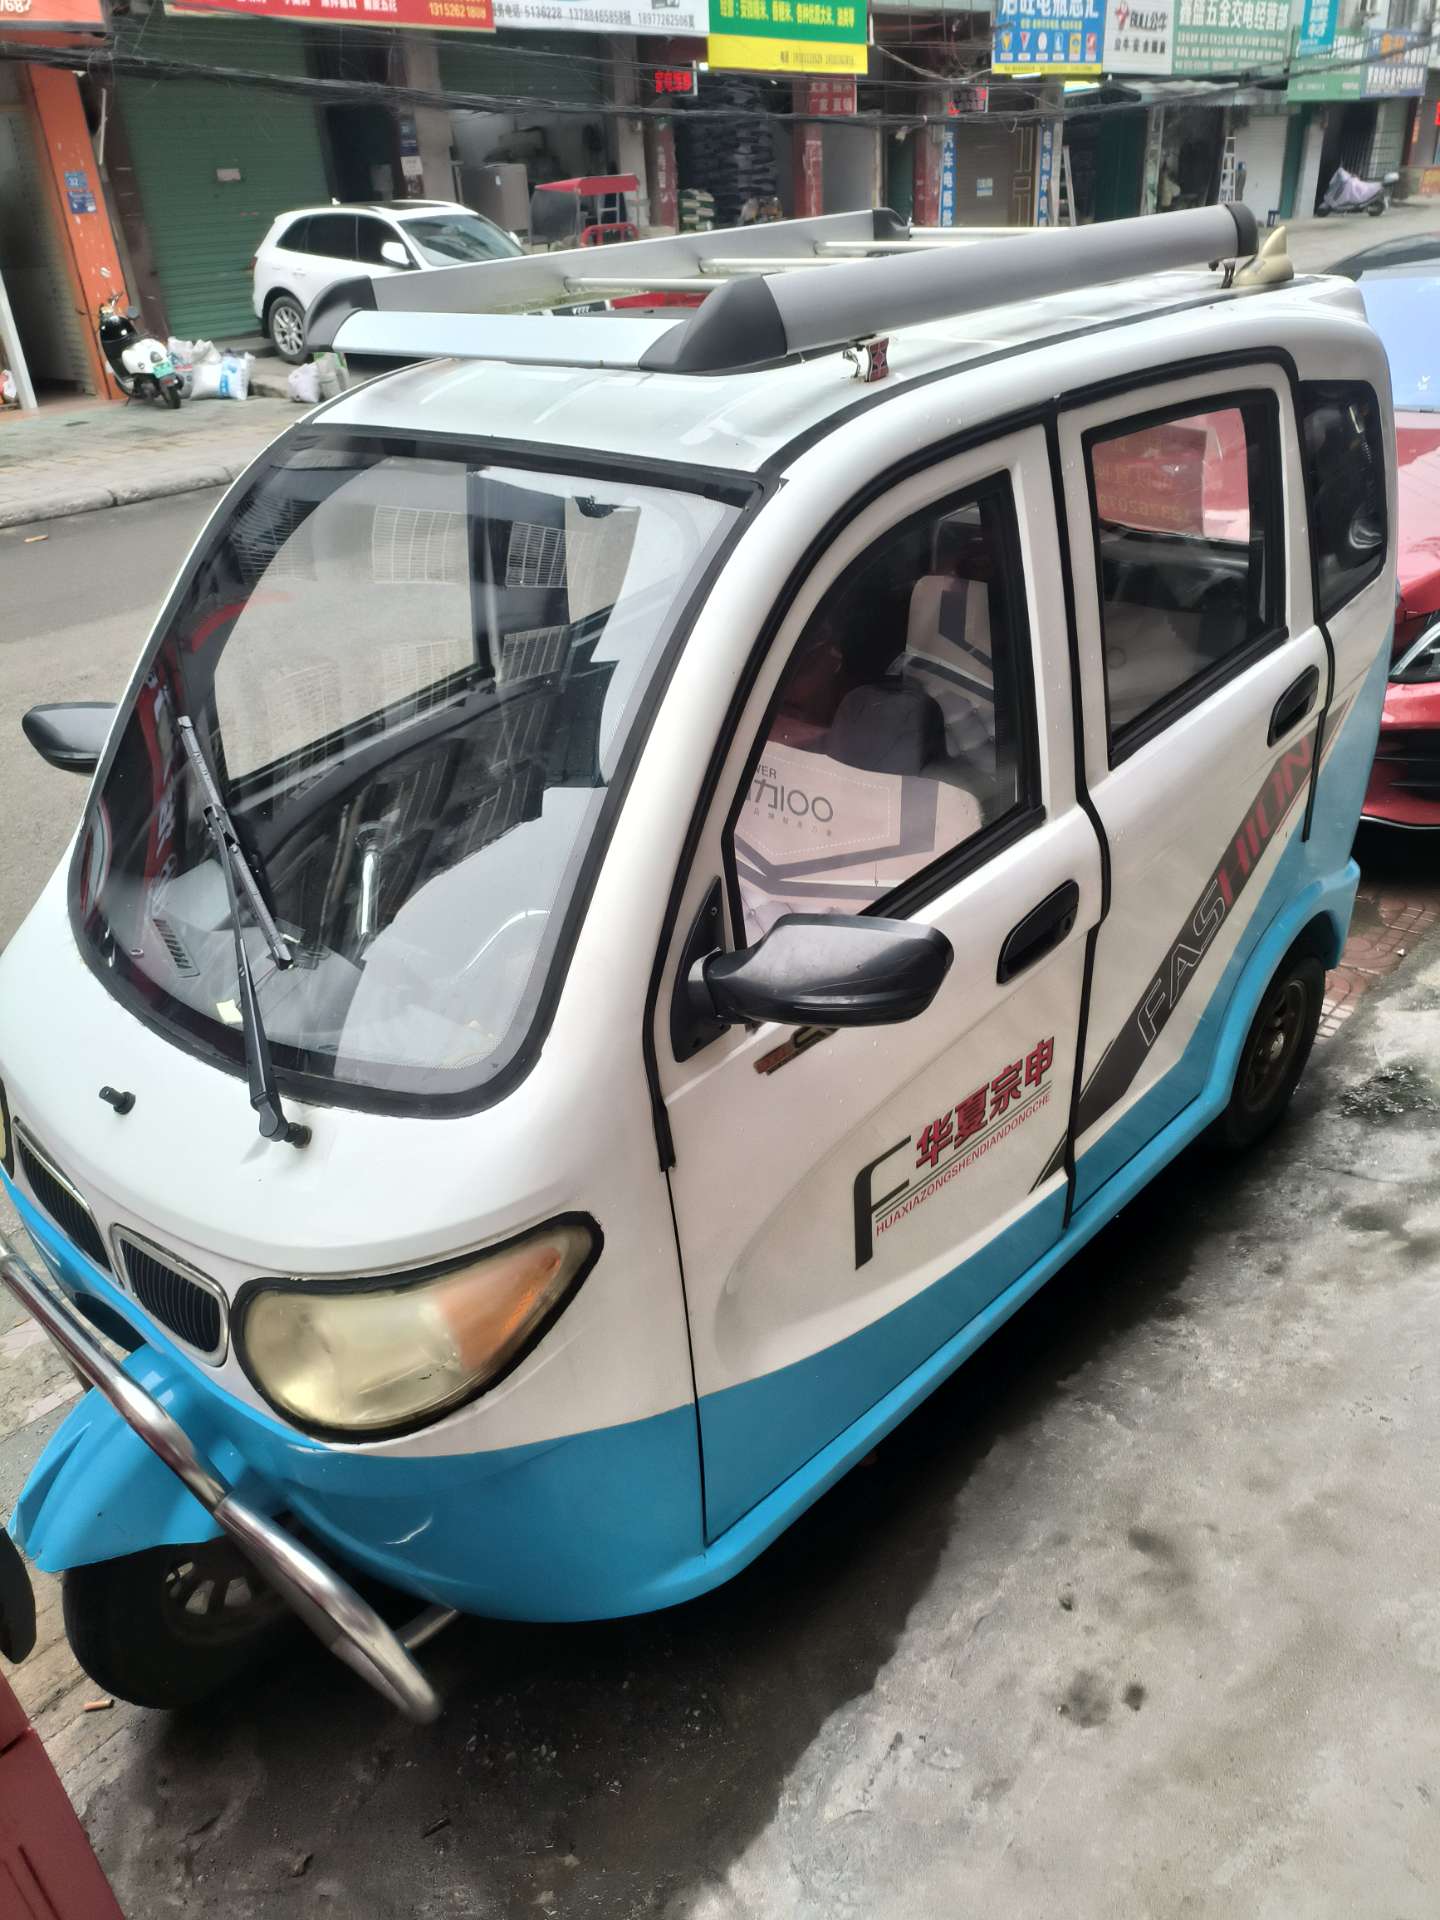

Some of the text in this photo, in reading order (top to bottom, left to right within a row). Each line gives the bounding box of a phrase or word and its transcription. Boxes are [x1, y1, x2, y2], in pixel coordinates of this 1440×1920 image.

[876, 1092, 1051, 1238] HUAXIAZONGSHENDIANDONGCHE
[915, 1036, 1055, 1169] 华夏宗申
